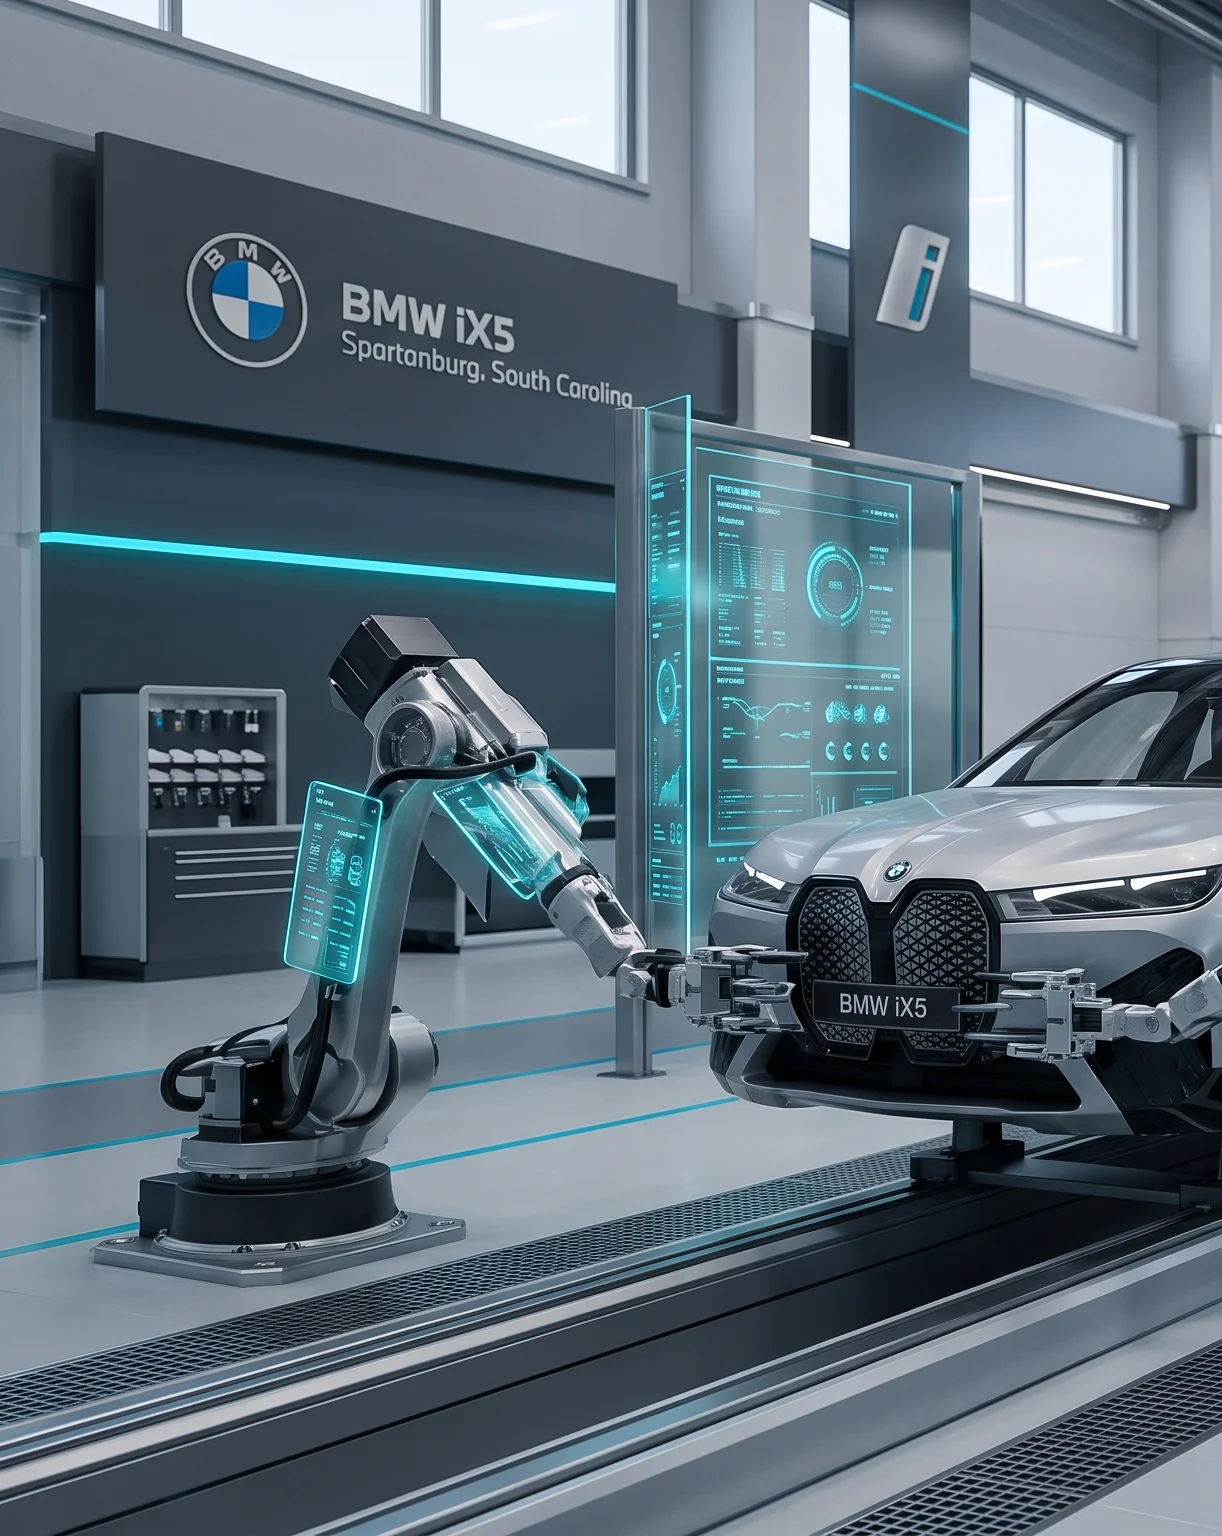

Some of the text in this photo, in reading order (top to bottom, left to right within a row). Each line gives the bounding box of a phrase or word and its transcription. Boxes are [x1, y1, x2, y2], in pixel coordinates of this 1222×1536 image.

[203, 240, 292, 284] BMW
[342, 282, 515, 354] BMW iX5
[341, 330, 633, 408] Spartanburg, South Carolina
[839, 992, 927, 1019] BMW iX5
